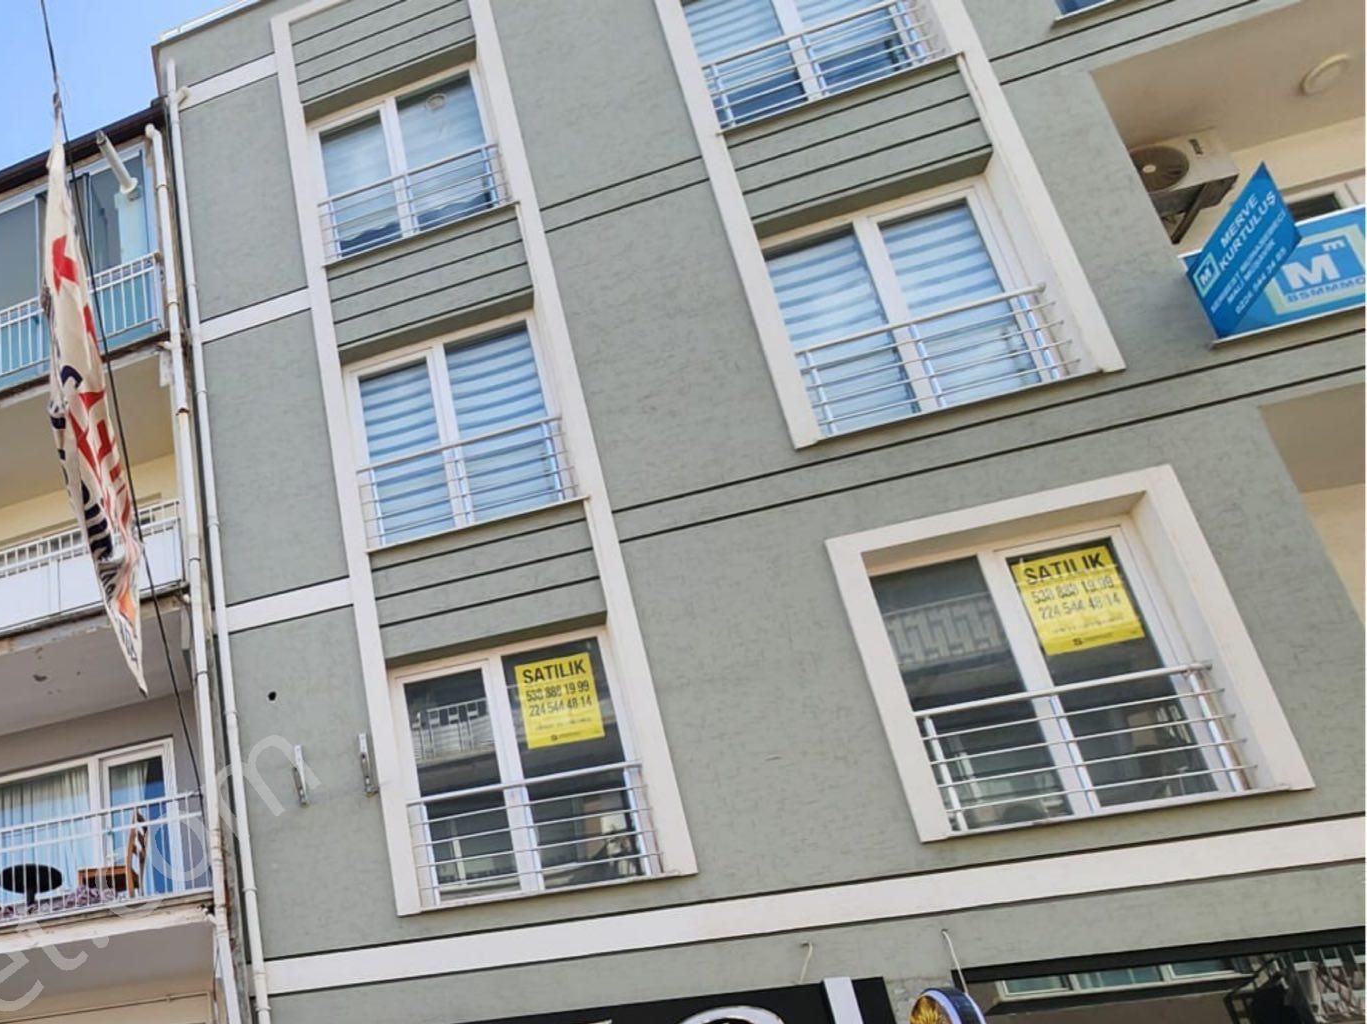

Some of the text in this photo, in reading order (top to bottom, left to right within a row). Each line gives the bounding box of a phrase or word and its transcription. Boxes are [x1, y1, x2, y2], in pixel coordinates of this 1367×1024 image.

[1220, 193, 1259, 248] MERVE
[1024, 553, 1106, 585] SATILIK
[1105, 592, 1122, 607] 14
[522, 659, 587, 684] SATILIK
[564, 681, 577, 695] 19
[529, 703, 547, 717] 224
[546, 700, 565, 714] 544
[581, 694, 593, 708] 14
